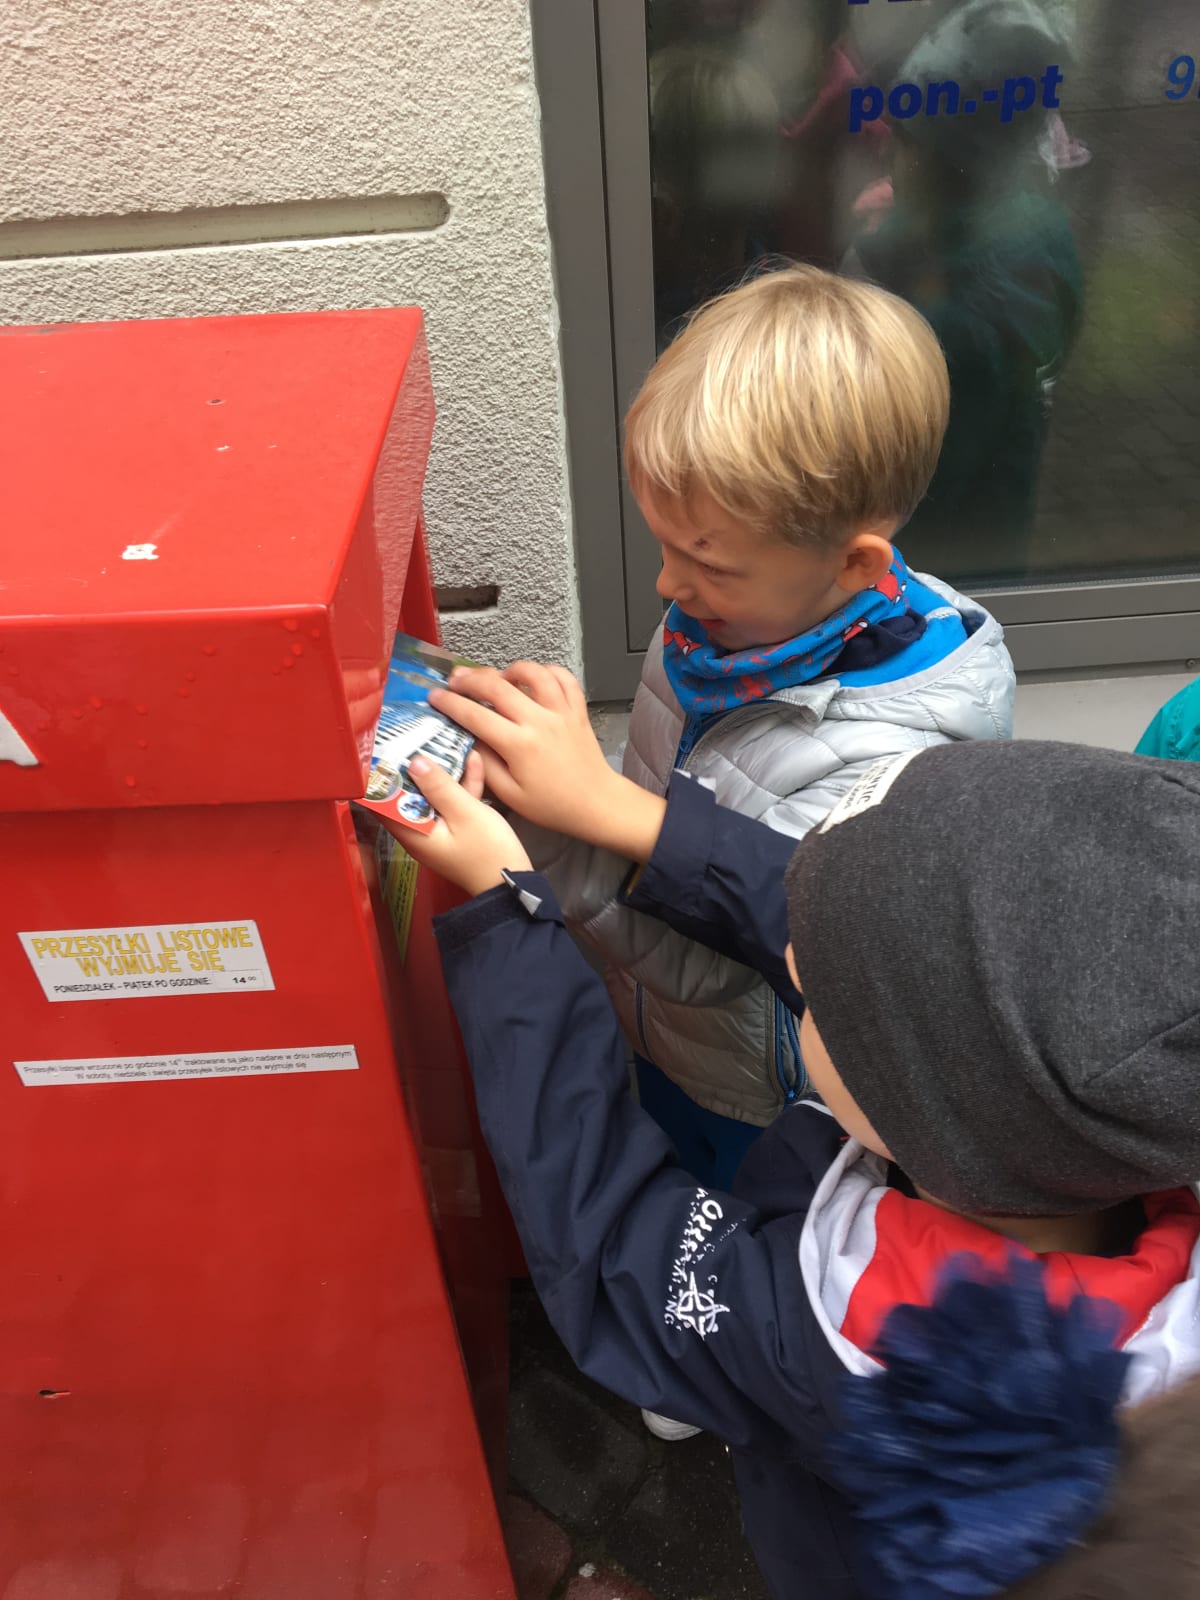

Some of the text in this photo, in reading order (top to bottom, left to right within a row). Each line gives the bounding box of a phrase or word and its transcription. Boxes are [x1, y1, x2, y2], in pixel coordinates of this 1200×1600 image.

[849, 54, 1200, 133] pon.-pt 9
[31, 926, 253, 959] PRZESYŁKI LISTOWE
[75, 952, 182, 977] WYJMUJE
[154, 979, 168, 988] PO
